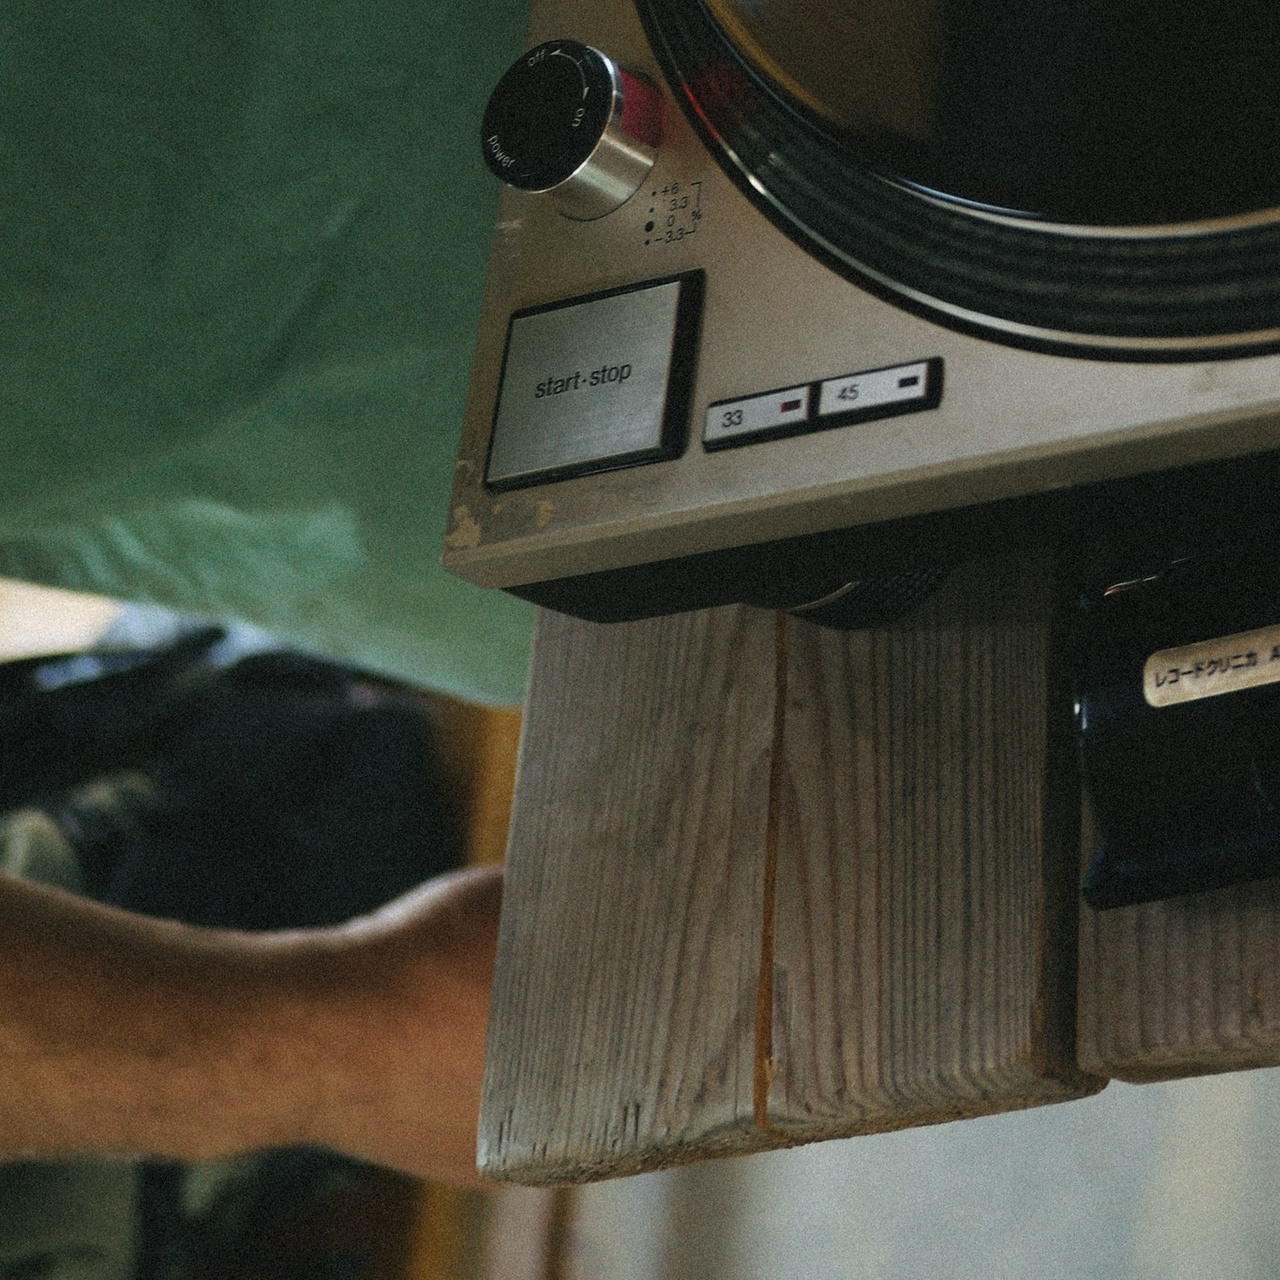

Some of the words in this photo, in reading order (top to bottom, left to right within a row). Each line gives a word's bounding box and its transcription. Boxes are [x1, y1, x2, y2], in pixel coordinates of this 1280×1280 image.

[527, 48, 547, 68] off
[571, 107, 586, 128] on
[487, 134, 517, 169] power
[661, 182, 680, 196] +6
[837, 383, 860, 402] 45
[720, 409, 744, 429] 33
